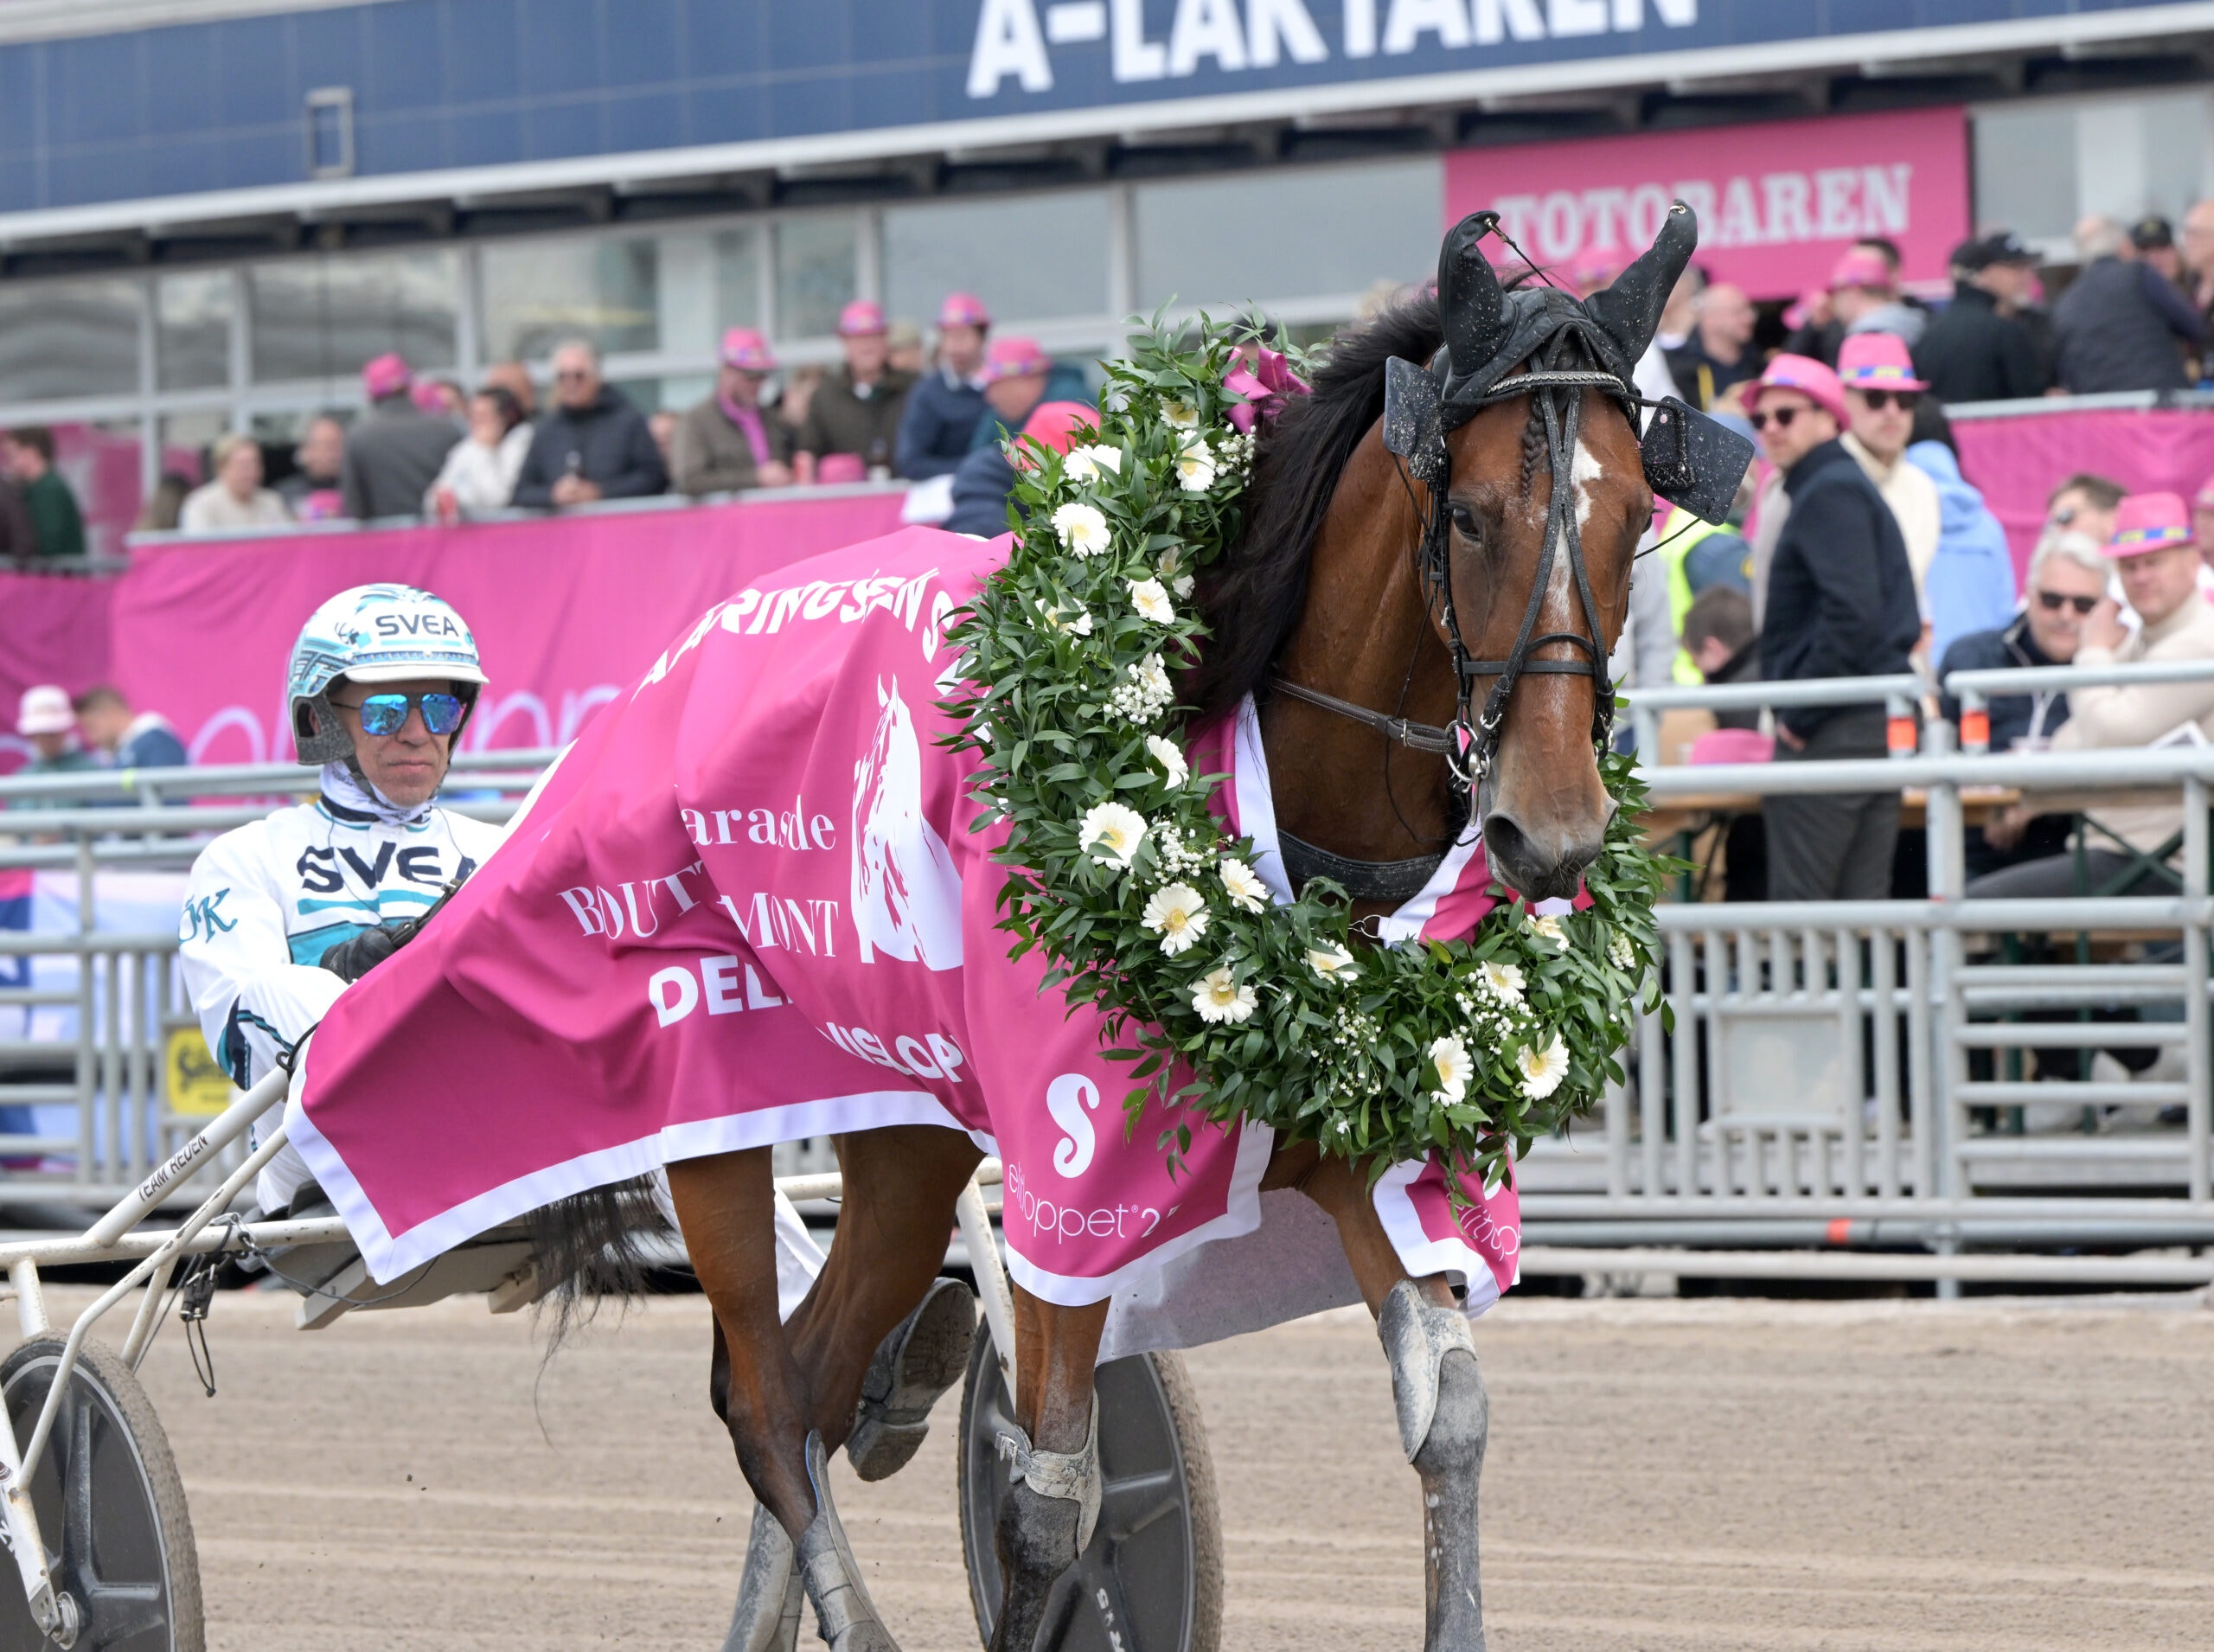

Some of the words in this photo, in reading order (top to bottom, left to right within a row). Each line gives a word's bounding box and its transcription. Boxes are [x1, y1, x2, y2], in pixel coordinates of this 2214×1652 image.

[1491, 163, 1914, 263] TOTOBAREN
[375, 614, 460, 637] SVEA
[649, 954, 794, 1028] DEL
